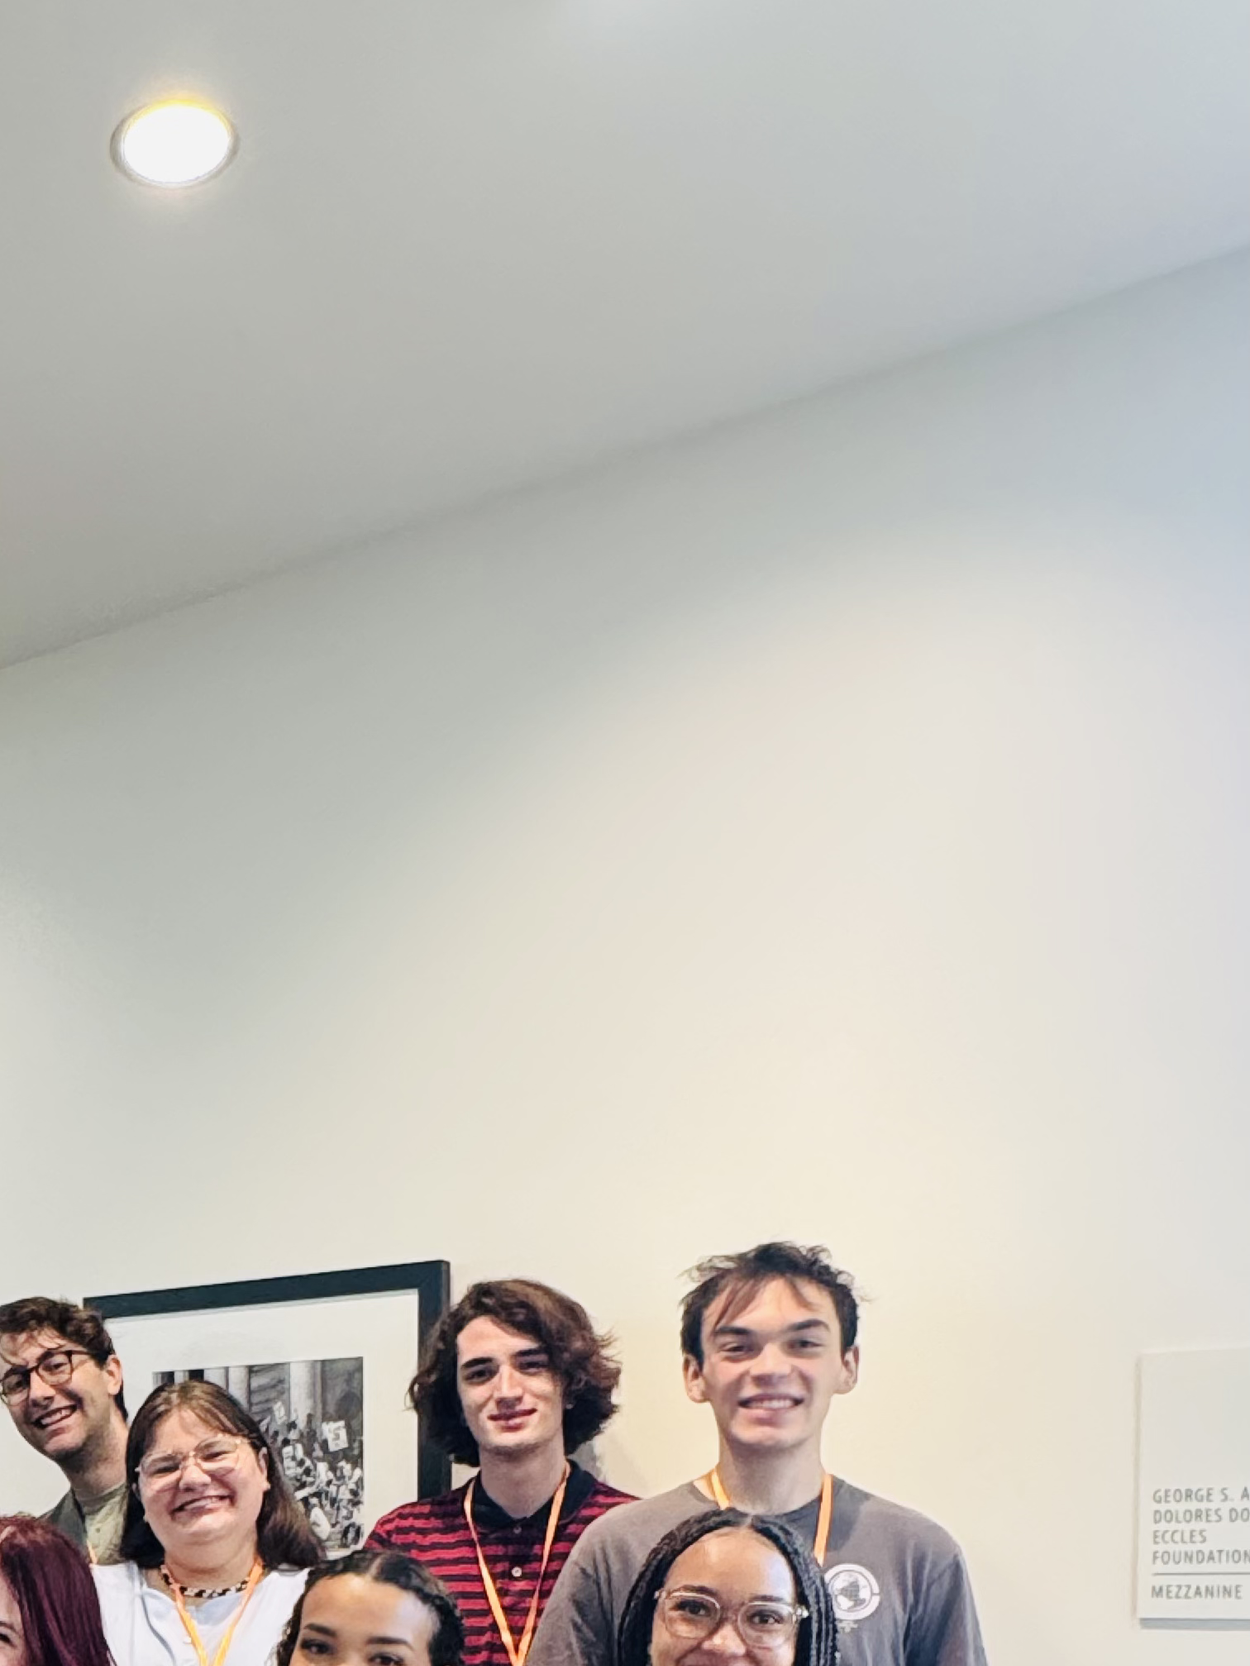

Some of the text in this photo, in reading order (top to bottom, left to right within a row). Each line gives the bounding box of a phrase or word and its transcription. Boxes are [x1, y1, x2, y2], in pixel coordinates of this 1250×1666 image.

[1152, 1487, 1214, 1504] GEORGE
[1220, 1487, 1235, 1503] S.
[1153, 1507, 1250, 1524] DOLORES DO
[1152, 1529, 1207, 1545] ECCLES
[1152, 1549, 1250, 1566] FOUNDATION
[1151, 1584, 1243, 1600] MEZZANINE
